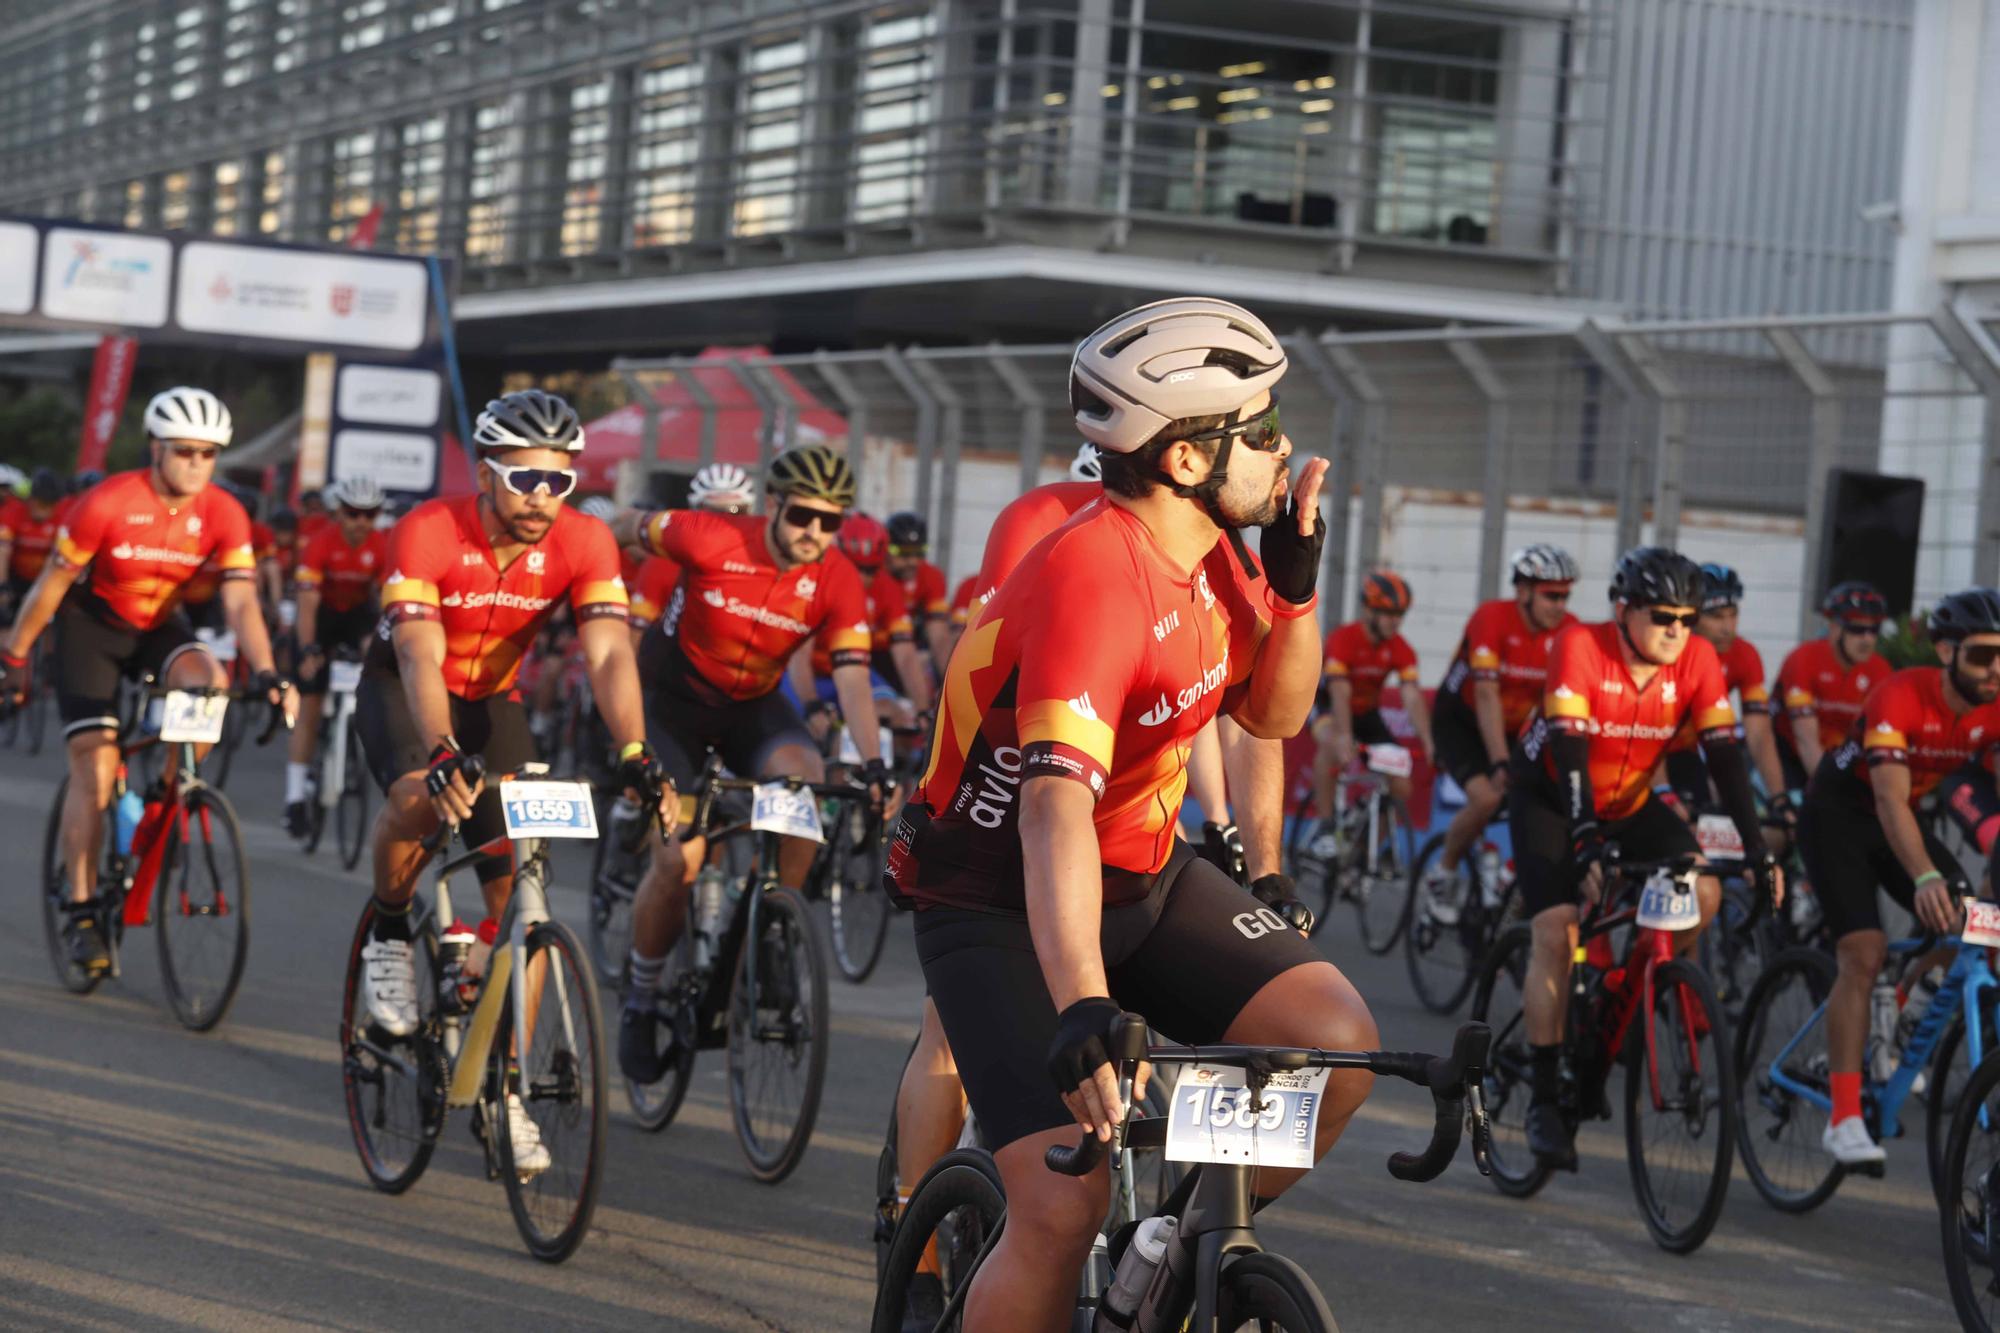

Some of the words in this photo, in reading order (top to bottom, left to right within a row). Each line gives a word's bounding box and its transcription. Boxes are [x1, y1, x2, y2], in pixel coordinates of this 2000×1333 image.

[954, 781, 973, 813] renfe
[969, 746, 1023, 829] avlo
[510, 799, 575, 822] 1659
[1187, 1088, 1286, 1130] 1589
[1296, 1096, 1312, 1117] km
[1293, 1119, 1308, 1144] 105
